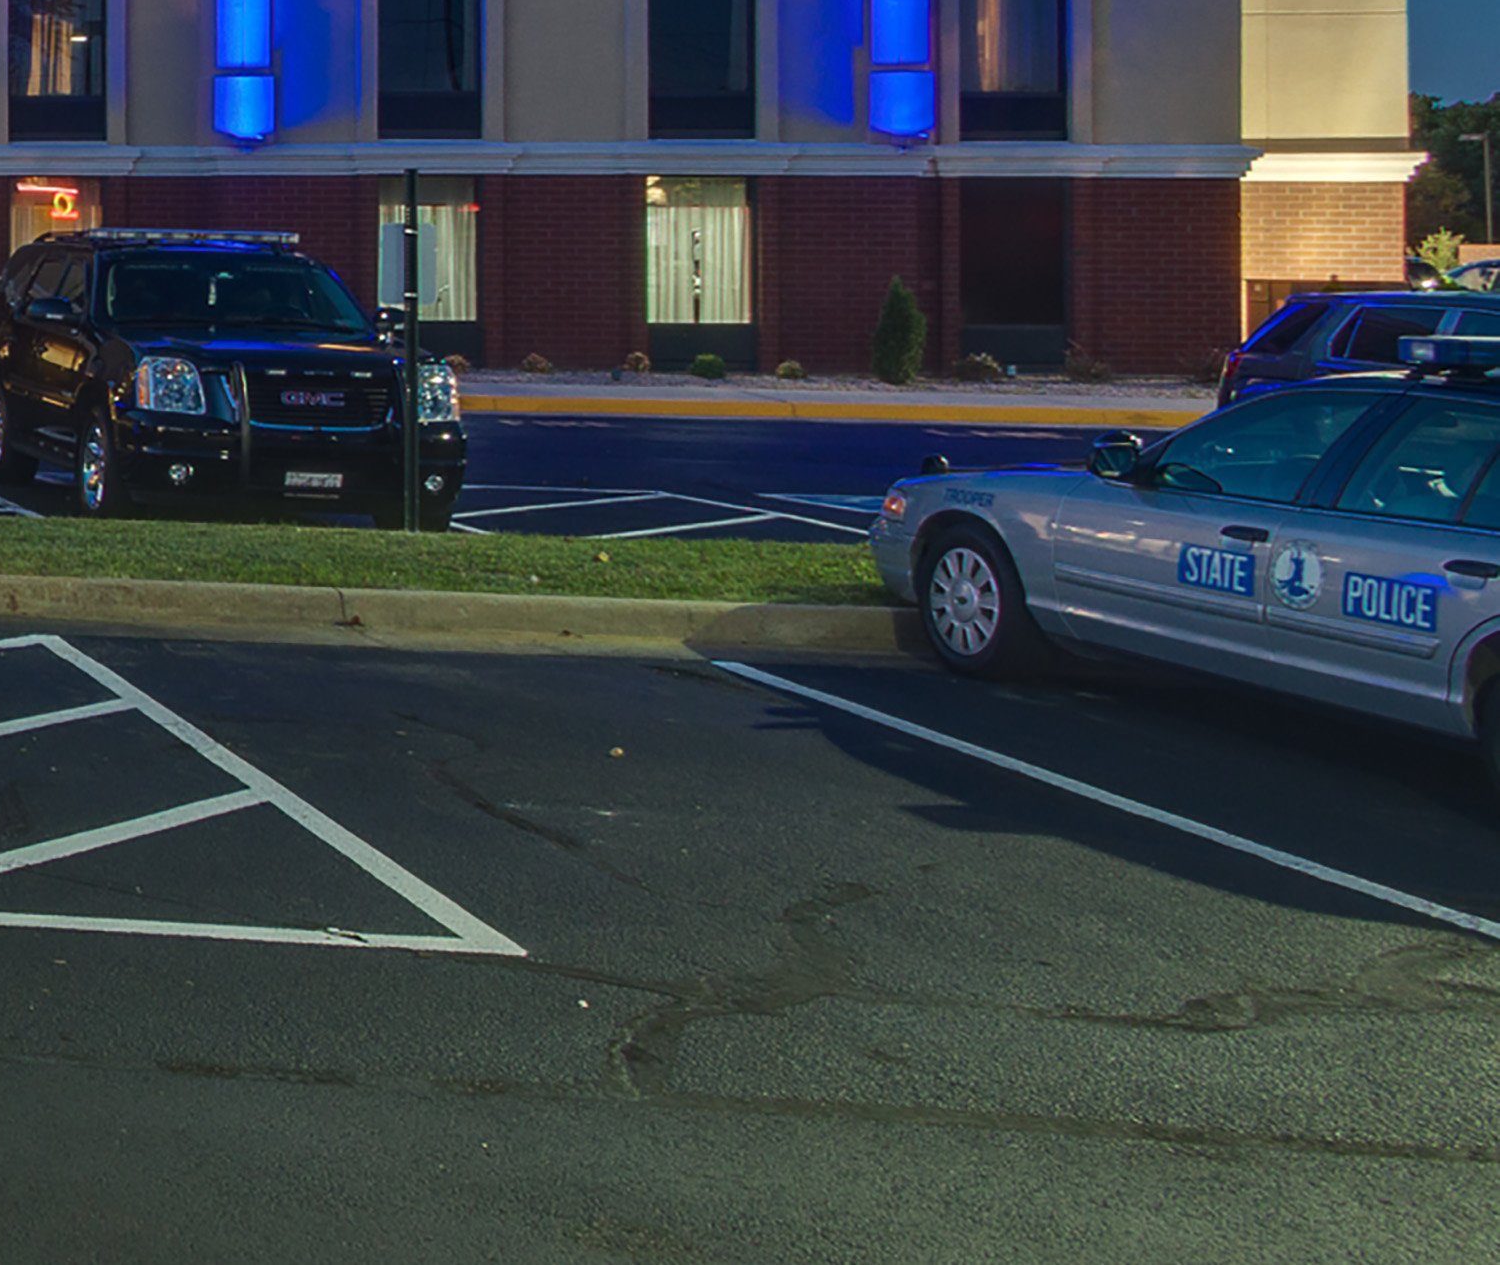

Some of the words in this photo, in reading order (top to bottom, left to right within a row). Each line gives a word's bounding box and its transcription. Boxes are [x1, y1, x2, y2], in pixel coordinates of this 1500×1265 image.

[281, 391, 345, 406] GMC
[944, 487, 995, 508] TROOPER
[1184, 546, 1249, 593] STATE
[1345, 574, 1432, 629] POLICE
